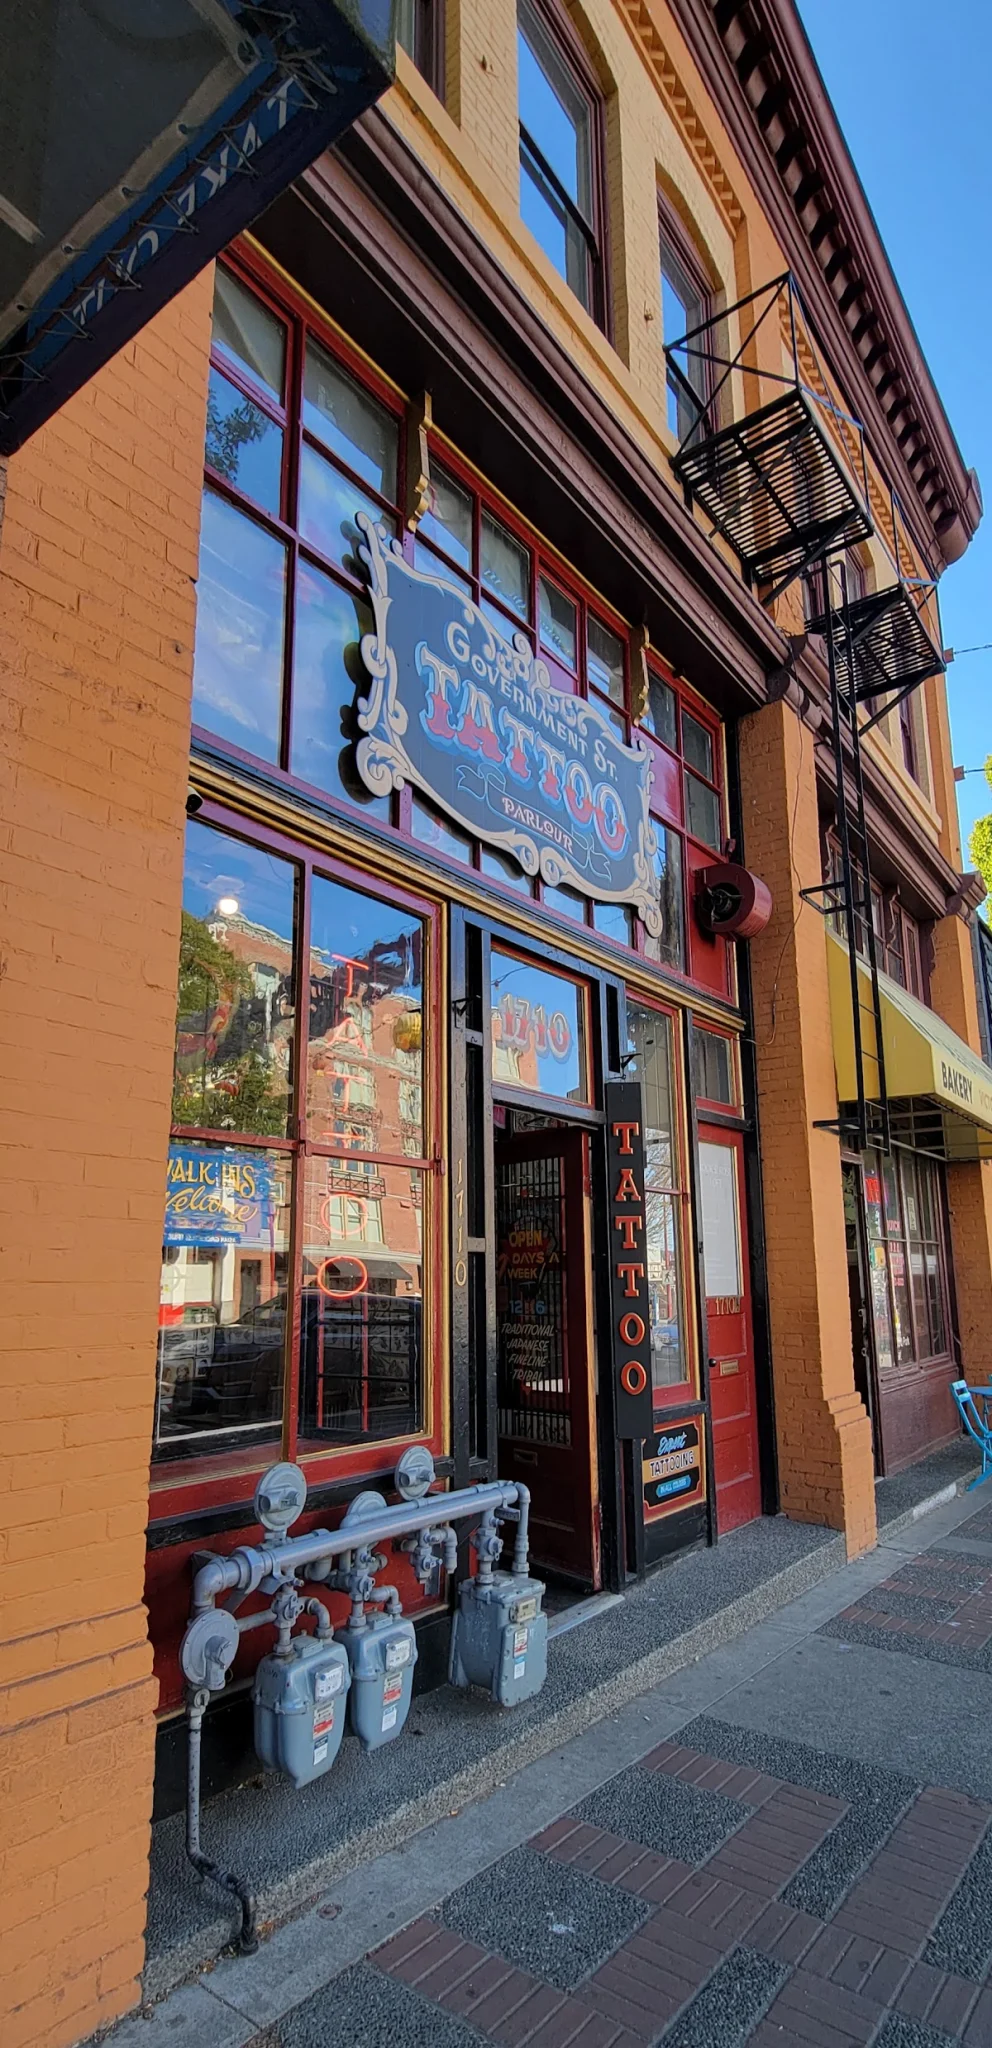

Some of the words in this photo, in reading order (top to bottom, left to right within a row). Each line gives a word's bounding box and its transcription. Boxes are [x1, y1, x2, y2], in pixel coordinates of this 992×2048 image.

[446, 621, 589, 757] GOVERNMENT
[417, 643, 629, 856] TATTOO
[502, 797, 574, 853] PARLOUR
[500, 993, 571, 1057] 1710
[941, 1060, 973, 1105] BAKERY
[317, 953, 370, 1299] TATTOO
[455, 1158, 467, 1287] 1710
[508, 1230, 543, 1247] OPEN
[512, 1252, 545, 1264] DAYS
[612, 1121, 647, 1396] TATTOO
[508, 1267, 538, 1280] WEEK
[509, 1300, 523, 1315] 12
[536, 1300, 545, 1315] 6
[501, 1323, 555, 1336] TRADITIONAL
[507, 1338, 549, 1352] JAPANESE
[508, 1354, 548, 1367] FINELINE
[512, 1369, 543, 1382] TRIBAL
[649, 1450, 695, 1478] TATTOOING
